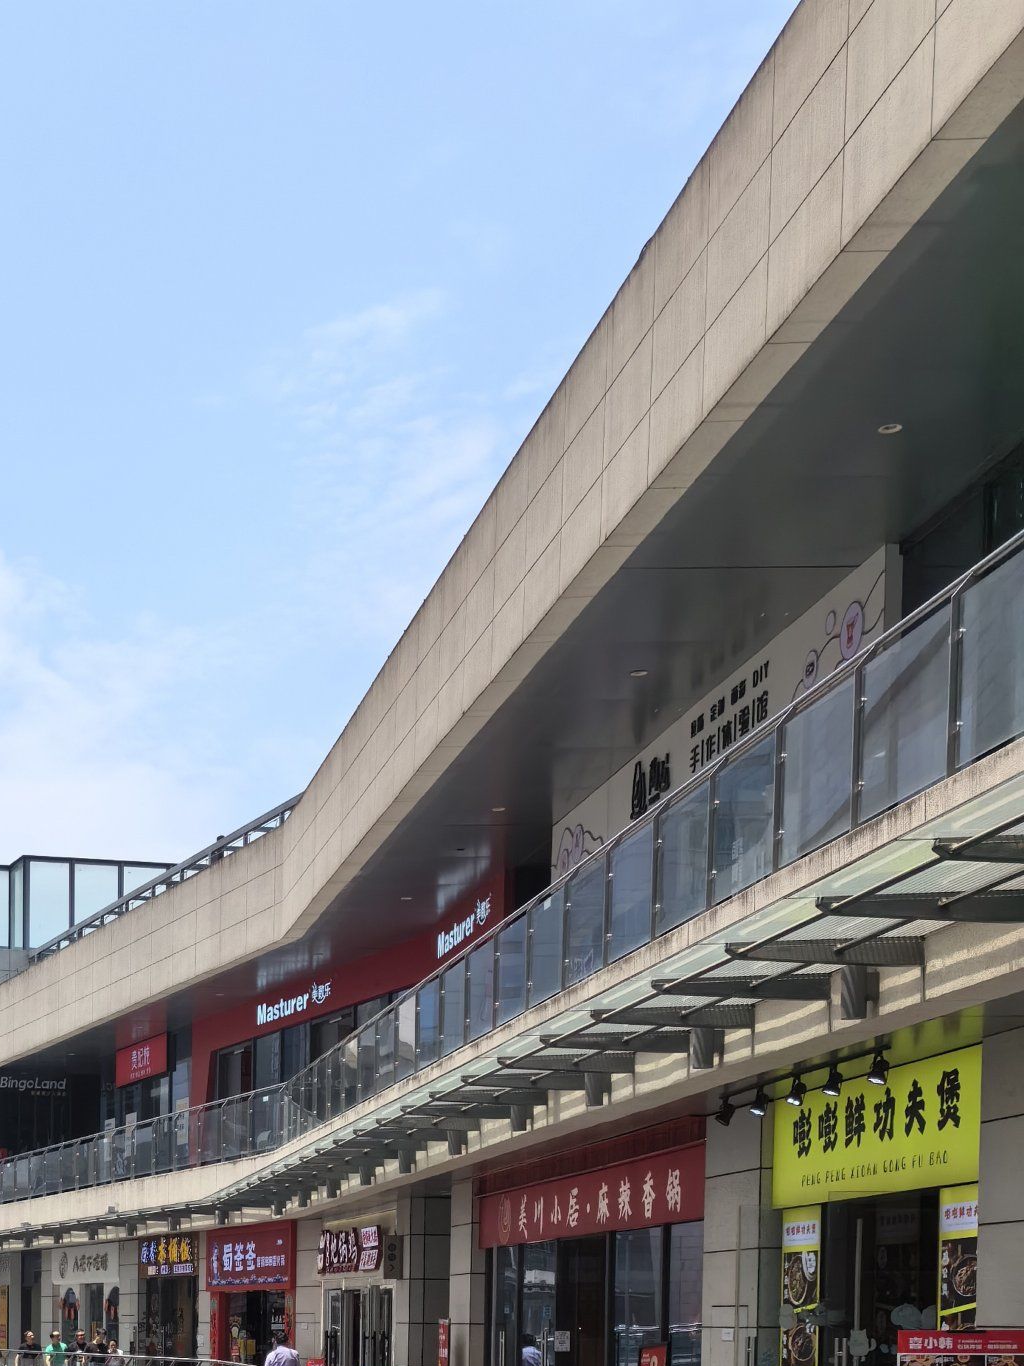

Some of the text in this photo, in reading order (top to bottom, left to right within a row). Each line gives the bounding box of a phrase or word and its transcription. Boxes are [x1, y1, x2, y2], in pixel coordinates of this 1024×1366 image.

[752, 661, 770, 688] DIY
[437, 913, 475, 959] Masturer
[257, 993, 309, 1025] Masturer
[0, 1076, 67, 1091] BingoLand
[792, 1068, 962, 1159] 嘭嘭鲜功夫煲
[801, 1169, 821, 1188] PENG
[825, 1166, 846, 1184] PENG
[883, 1156, 906, 1174] GONG
[929, 1150, 949, 1166] BAO
